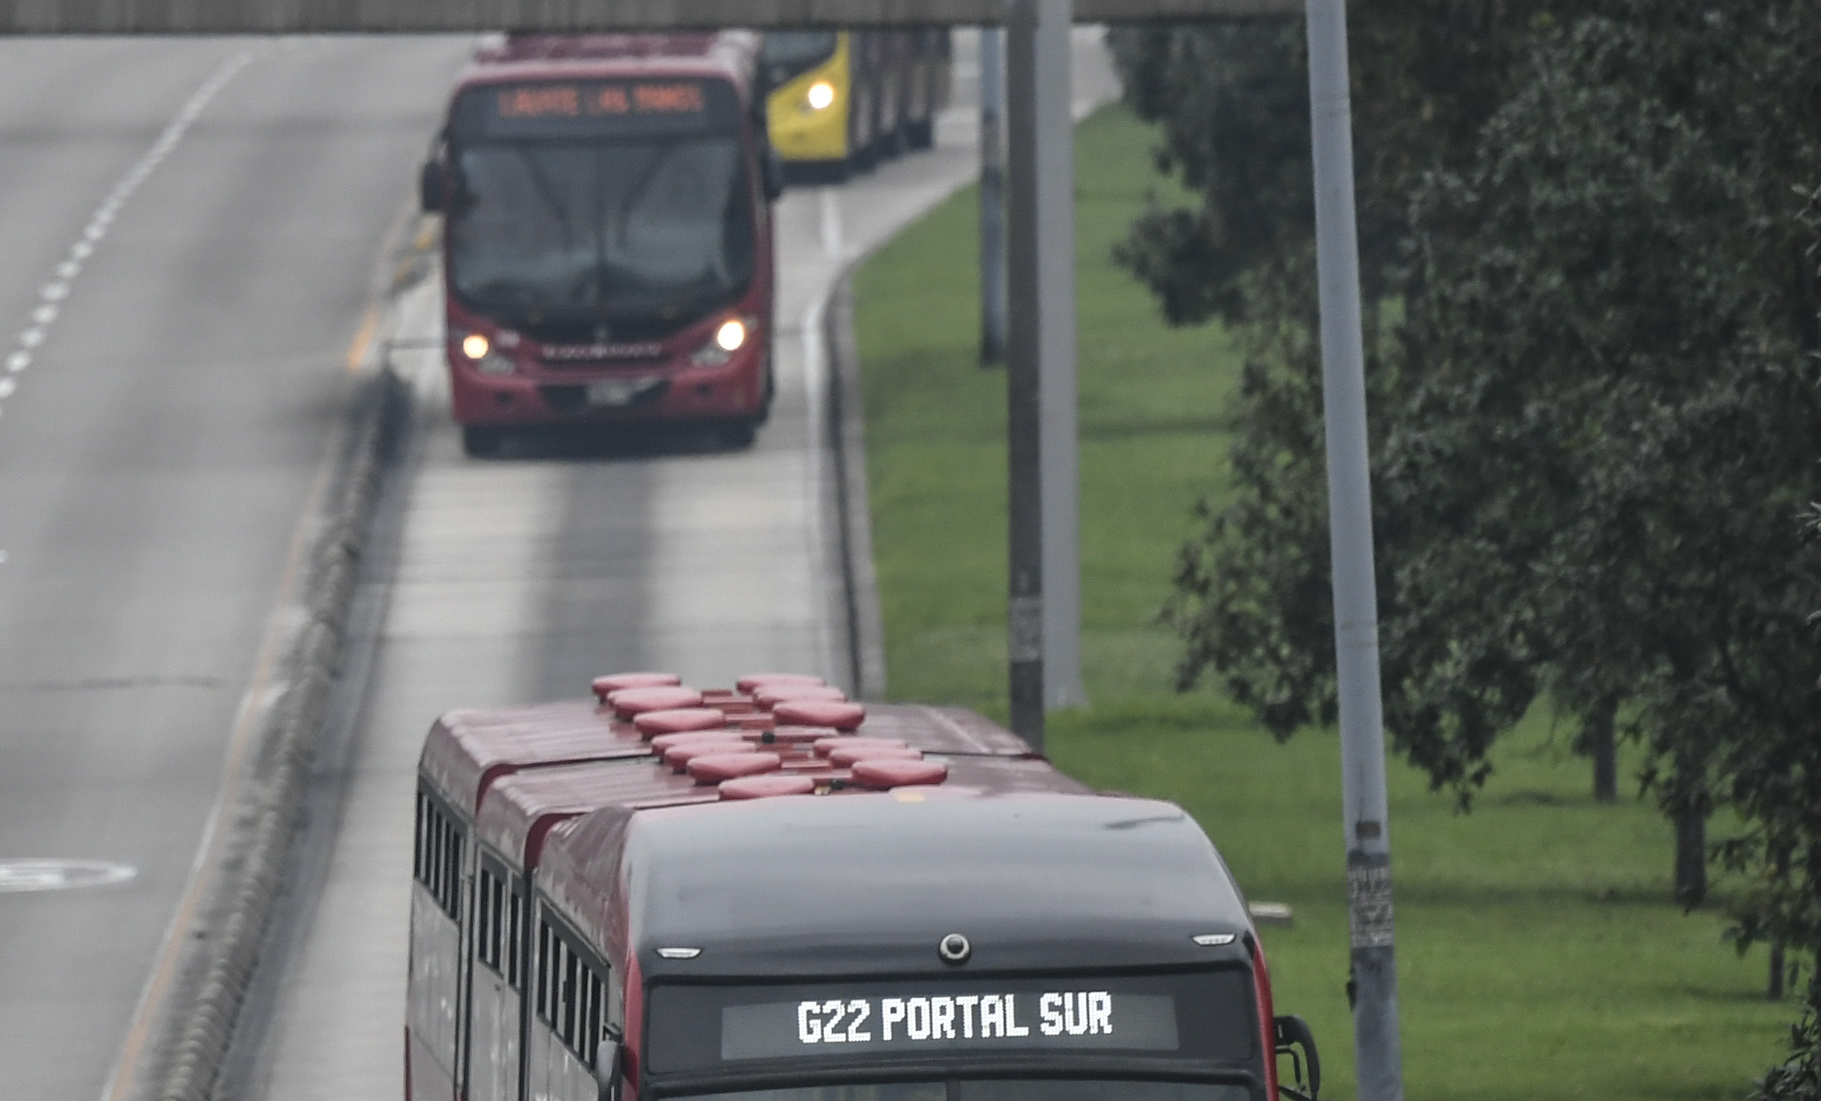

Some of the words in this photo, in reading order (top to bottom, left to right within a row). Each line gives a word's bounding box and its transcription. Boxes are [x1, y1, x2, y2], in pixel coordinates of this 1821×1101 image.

[797, 1000, 872, 1044] G22
[882, 994, 1029, 1040] PORTAL
[1040, 991, 1113, 1036] SUR
